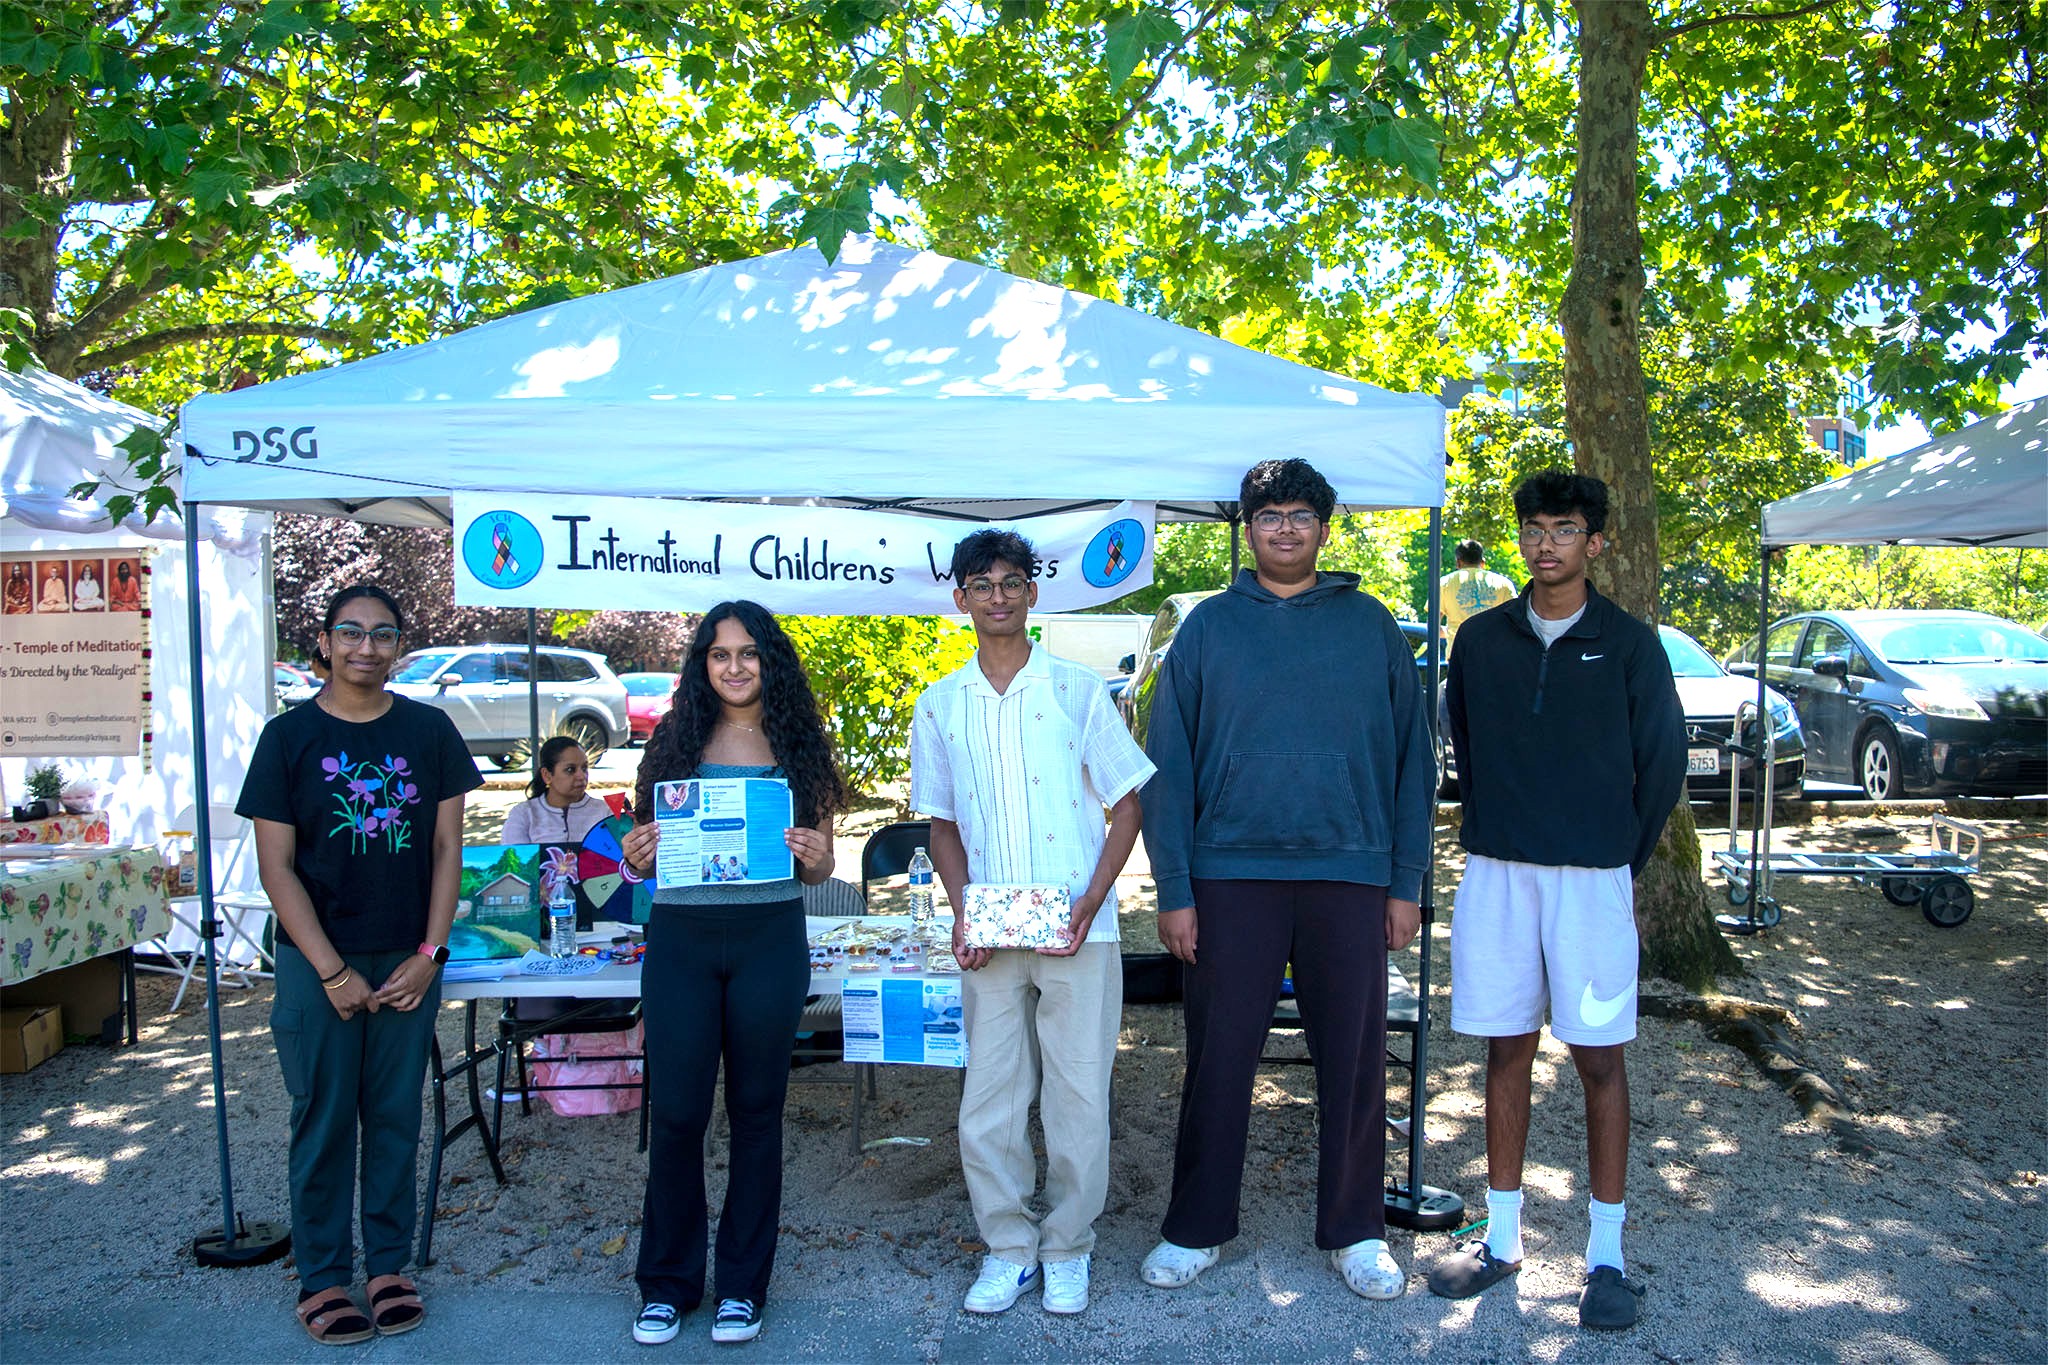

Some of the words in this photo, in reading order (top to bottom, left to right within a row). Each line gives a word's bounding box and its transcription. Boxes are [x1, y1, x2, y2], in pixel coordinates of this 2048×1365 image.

[233, 426, 318, 464] DSG
[552, 515, 722, 575] International
[750, 534, 895, 584] Children's
[13, 641, 58, 655] Temple
[61, 641, 74, 653] of
[10, 665, 54, 678] Directed
[56, 665, 70, 681] by
[72, 664, 89, 677] the
[1688, 757, 1716, 770] 6753
